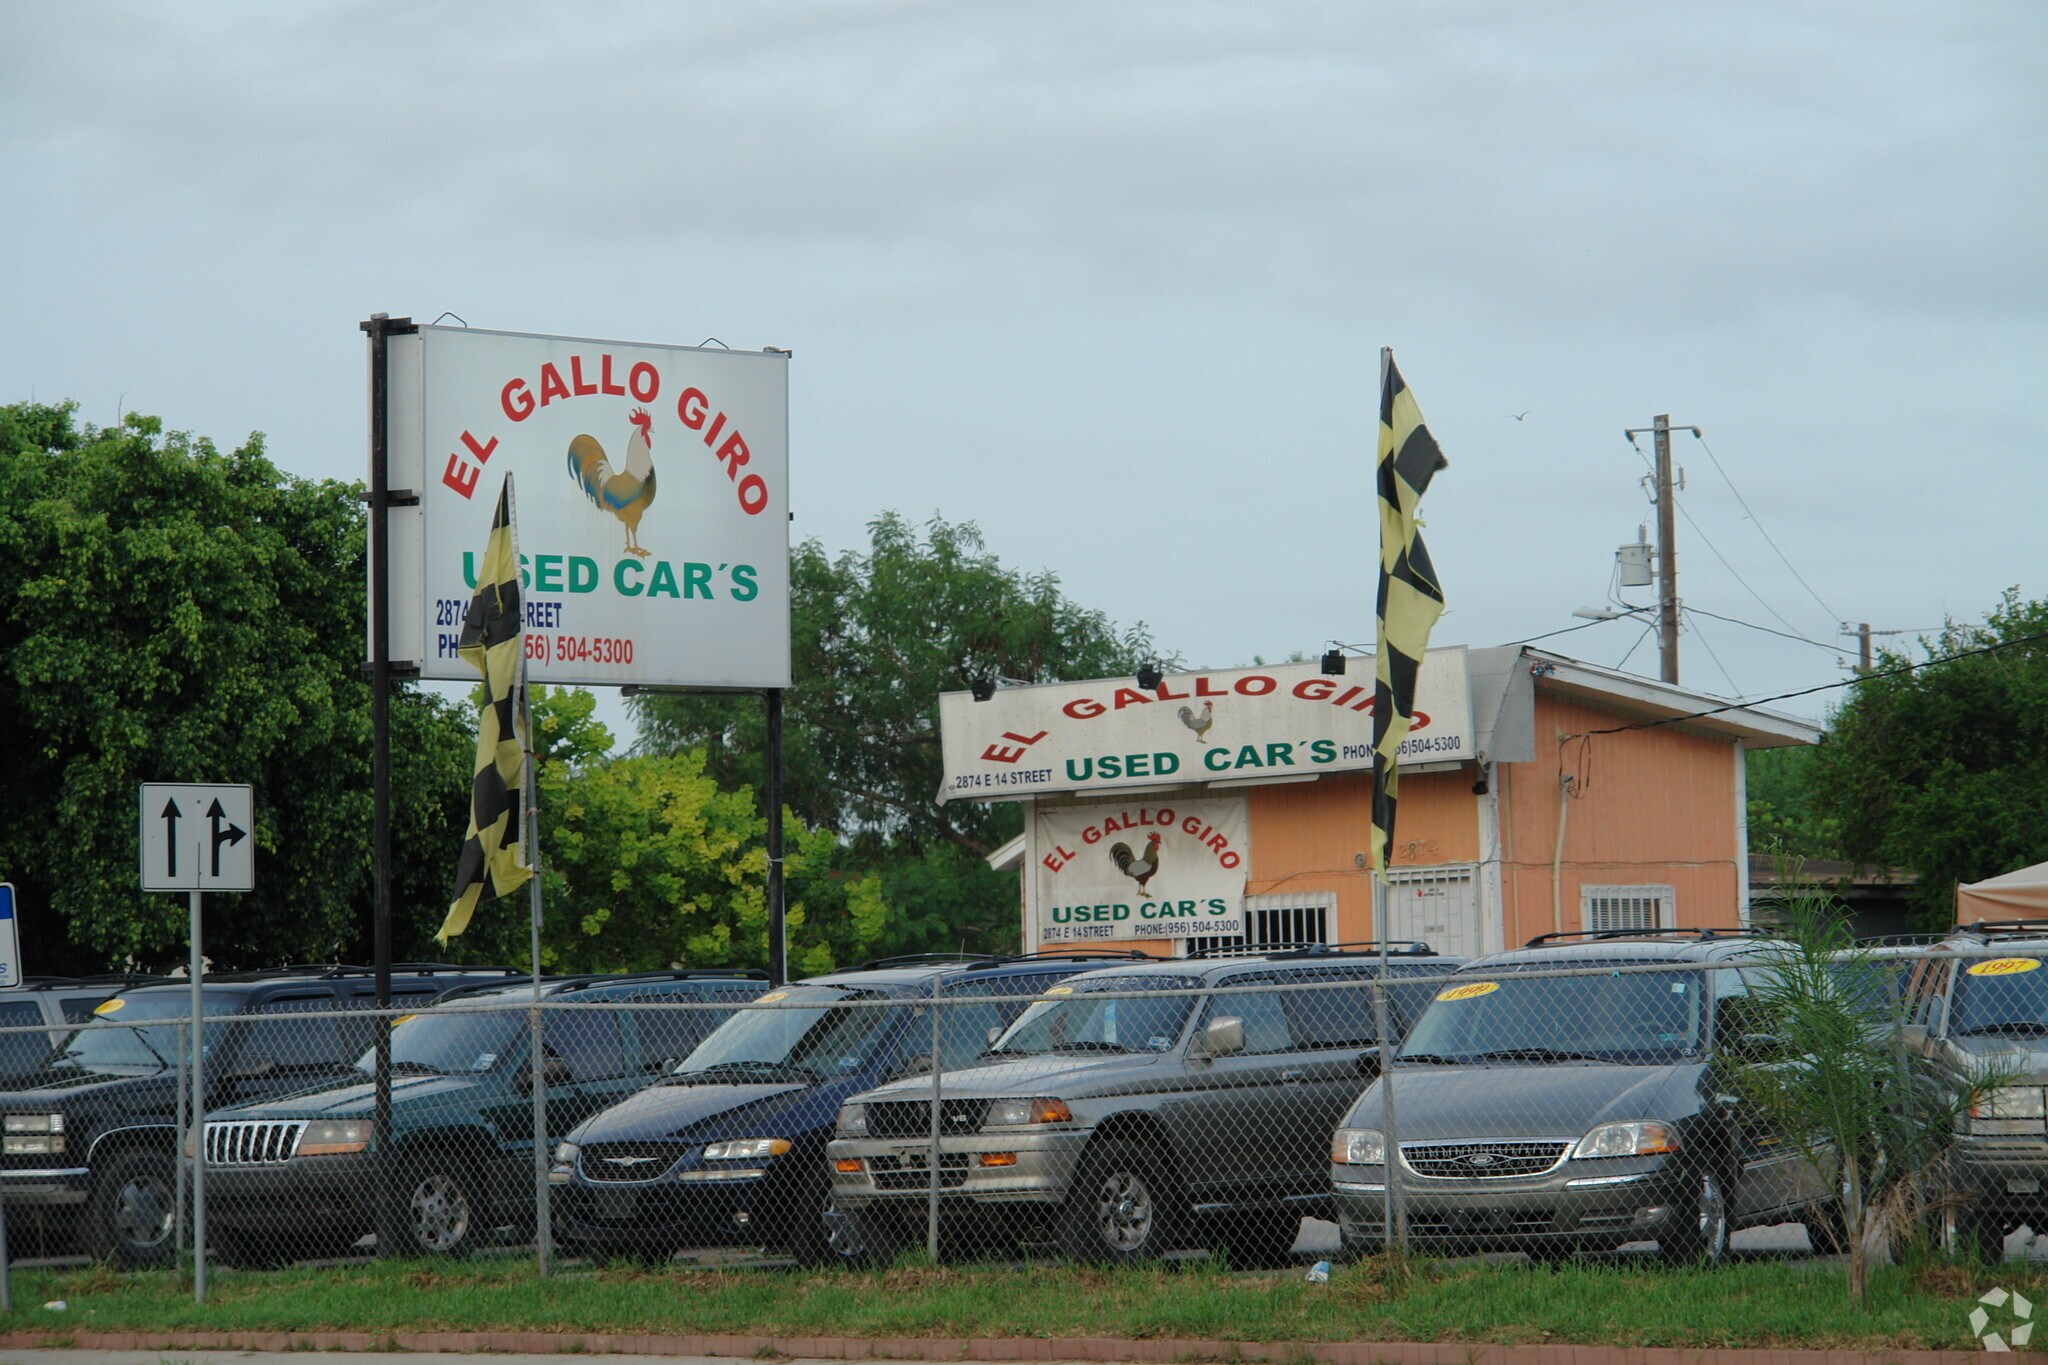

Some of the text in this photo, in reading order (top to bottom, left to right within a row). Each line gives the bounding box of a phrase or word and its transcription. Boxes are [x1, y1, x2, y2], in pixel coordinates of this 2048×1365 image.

[442, 353, 768, 516] EL GALLO GIRO
[436, 599, 562, 628] 2874 REET
[556, 635, 634, 664] 504-5300
[980, 730, 1049, 764] EL
[1062, 675, 1277, 720] GALLO
[956, 768, 1053, 789] 2874 E 14 STREET
[1066, 751, 1180, 781] USED
[1042, 807, 1241, 874] EL GALLO GIRO
[1052, 903, 1130, 924] USED
[1192, 920, 1239, 933] 504-5300
[1043, 927, 1061, 939] 2874
[1064, 927, 1070, 938] E
